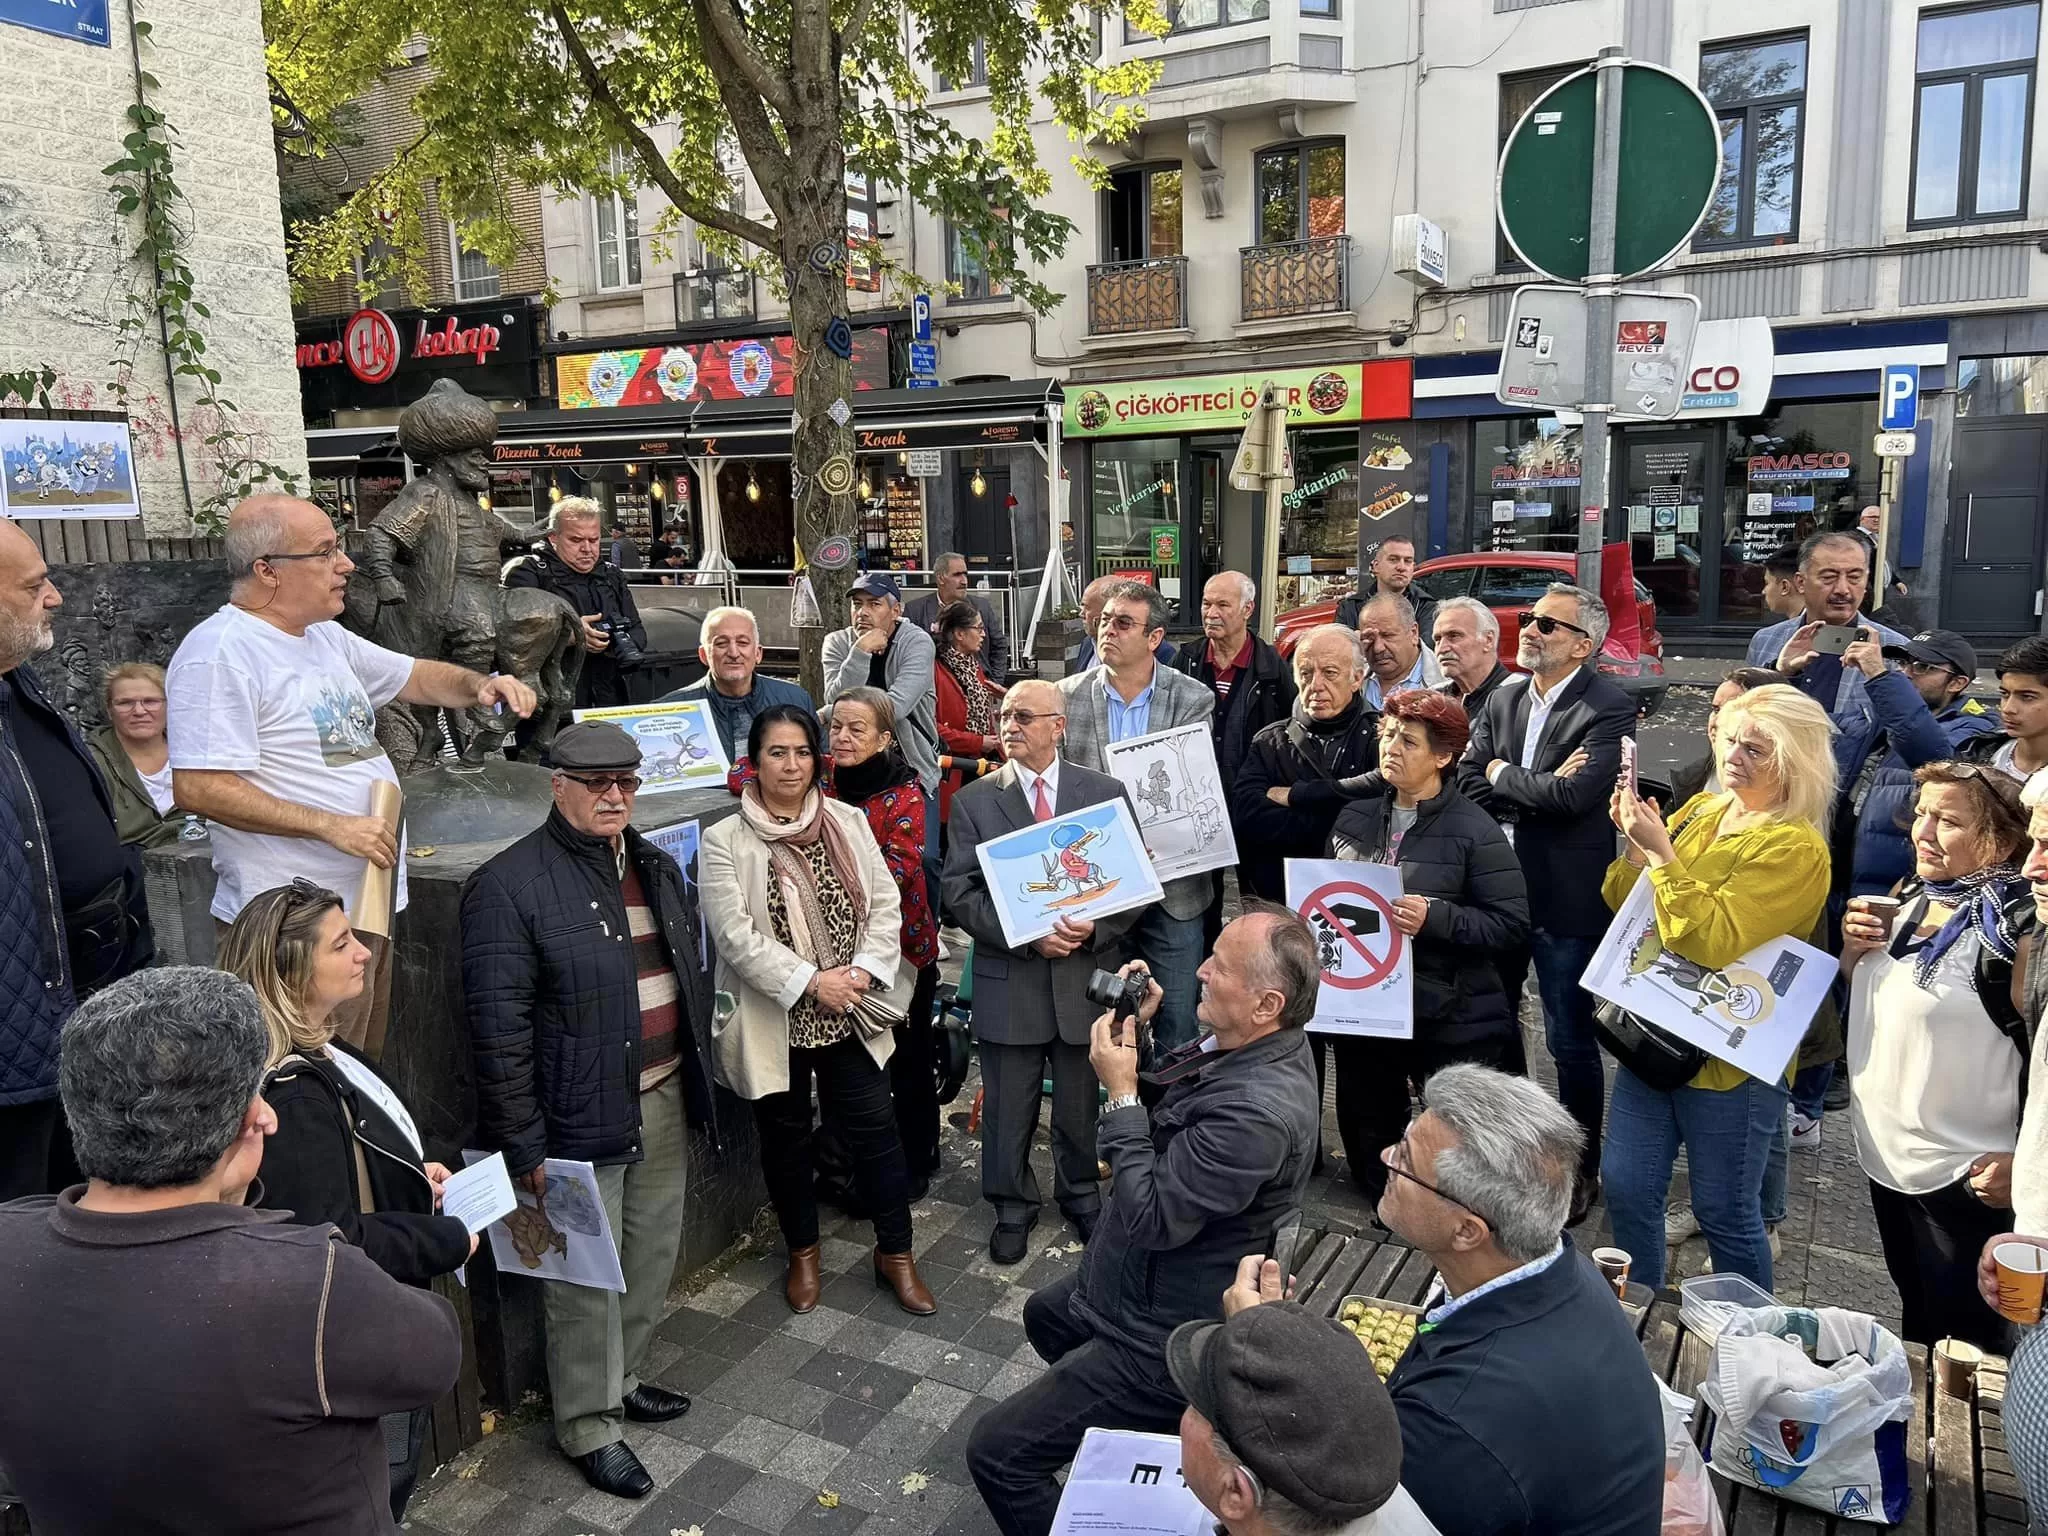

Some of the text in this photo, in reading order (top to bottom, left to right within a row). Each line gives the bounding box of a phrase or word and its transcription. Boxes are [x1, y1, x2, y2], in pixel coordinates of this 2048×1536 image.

[77, 22, 104, 36] STRAAT
[915, 301, 929, 333] P
[411, 316, 500, 364] kebap
[1618, 345, 1662, 353] #EVET
[296, 340, 343, 368] nce
[1115, 386, 1301, 421] ÇİĞKÖFTECİ ÖR
[1886, 373, 1914, 418] P
[857, 430, 908, 448] Koçak
[494, 444, 582, 461] Pizzeria Koçak
[1748, 452, 1851, 471] FIMASCO
[1492, 461, 1581, 479] FIMASCO
[1283, 466, 1348, 509] egetarian
